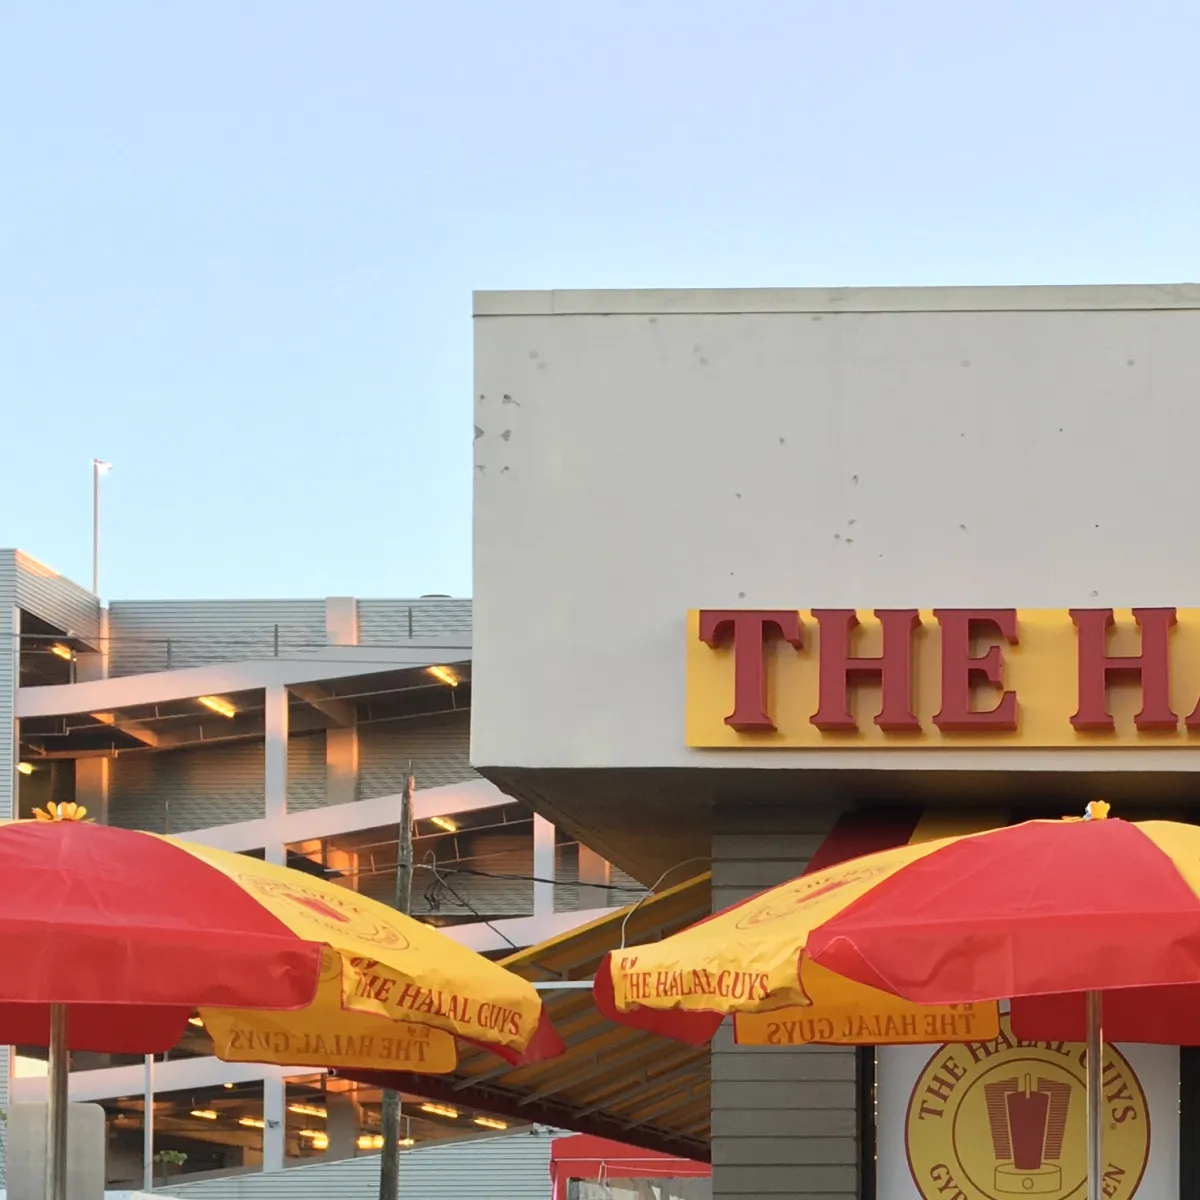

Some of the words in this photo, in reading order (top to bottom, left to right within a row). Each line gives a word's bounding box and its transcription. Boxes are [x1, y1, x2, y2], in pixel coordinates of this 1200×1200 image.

[699, 608, 1019, 733] THE
[396, 983, 472, 1024] HALAL
[477, 1001, 523, 1036] GUYS
[622, 972, 650, 1000] THE
[656, 968, 715, 998] HALAL
[718, 969, 769, 1001] GUYS
[918, 1056, 967, 1121] THE
